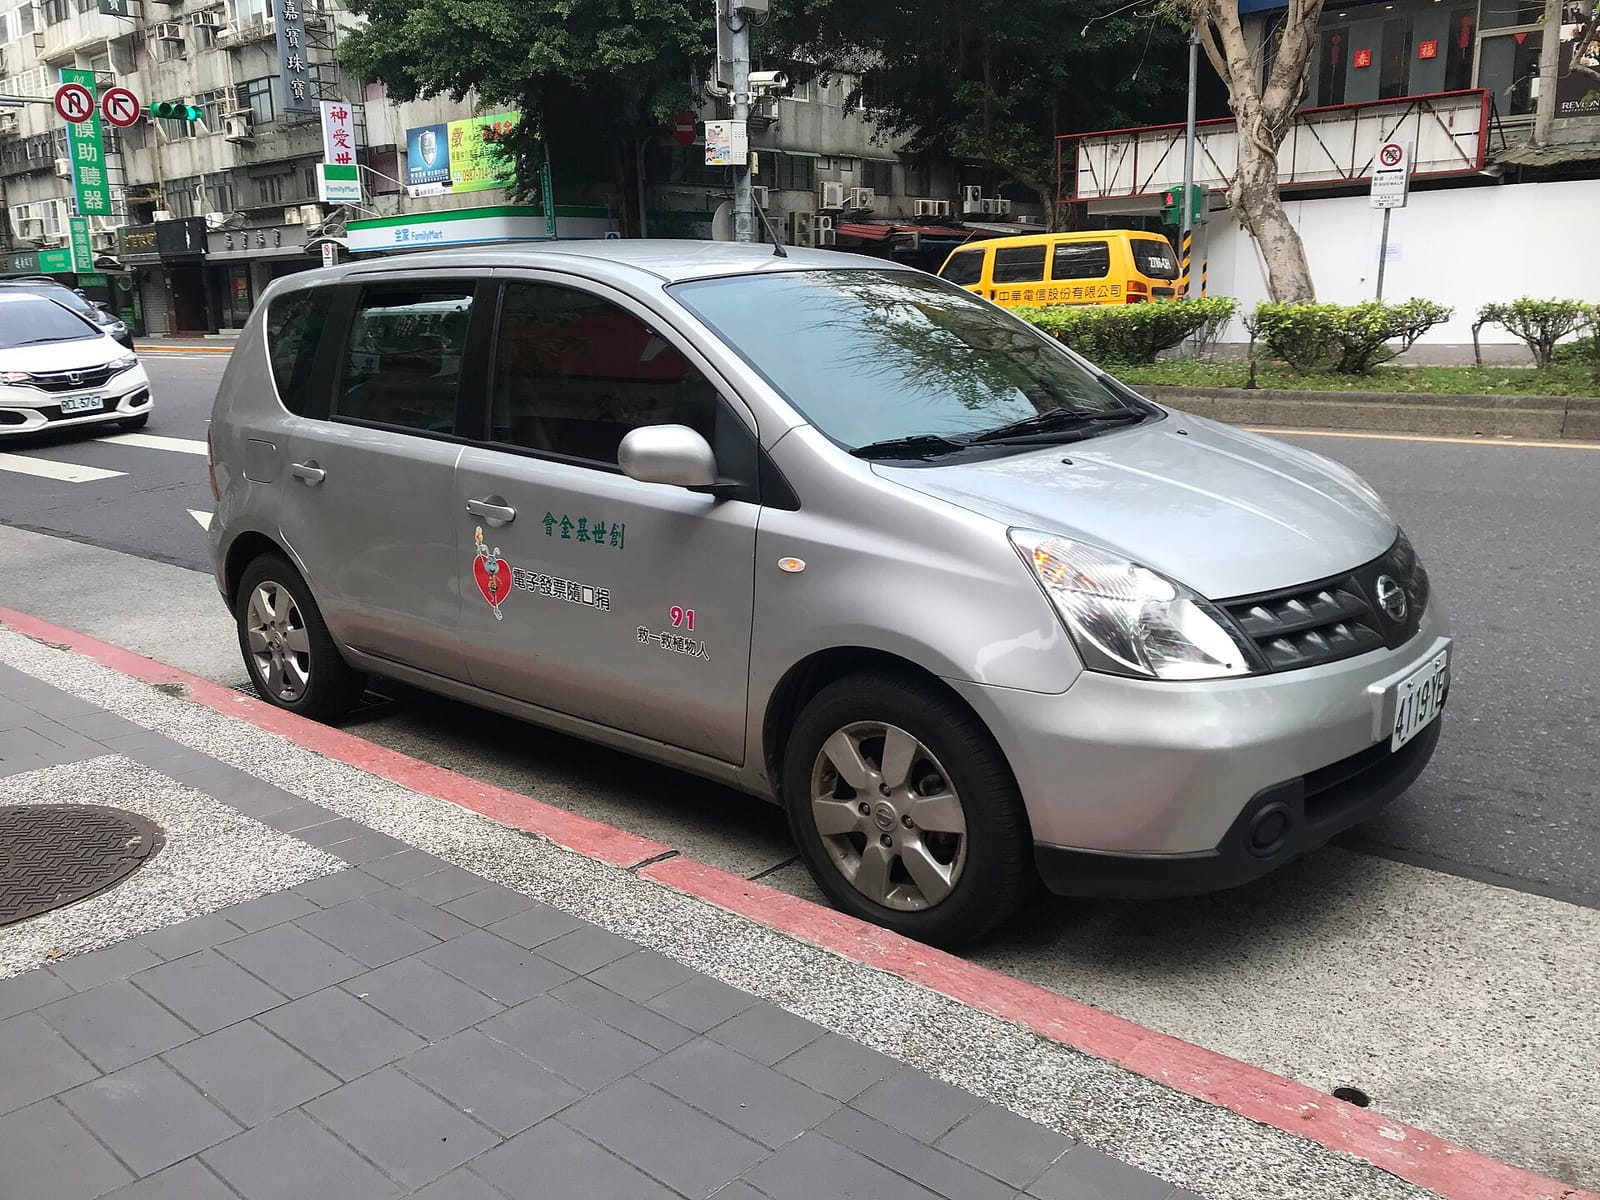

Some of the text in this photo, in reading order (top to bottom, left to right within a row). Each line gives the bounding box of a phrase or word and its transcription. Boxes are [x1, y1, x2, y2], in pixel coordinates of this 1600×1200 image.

[326, 185, 359, 194] FamilyMart
[394, 228, 443, 242] 全家 FamilyMart
[999, 284, 1122, 302] 中華電信股份有限公司
[512, 567, 611, 611] 電子發票隨口捐
[669, 605, 696, 632] 91
[636, 625, 711, 662] 救一救植物人
